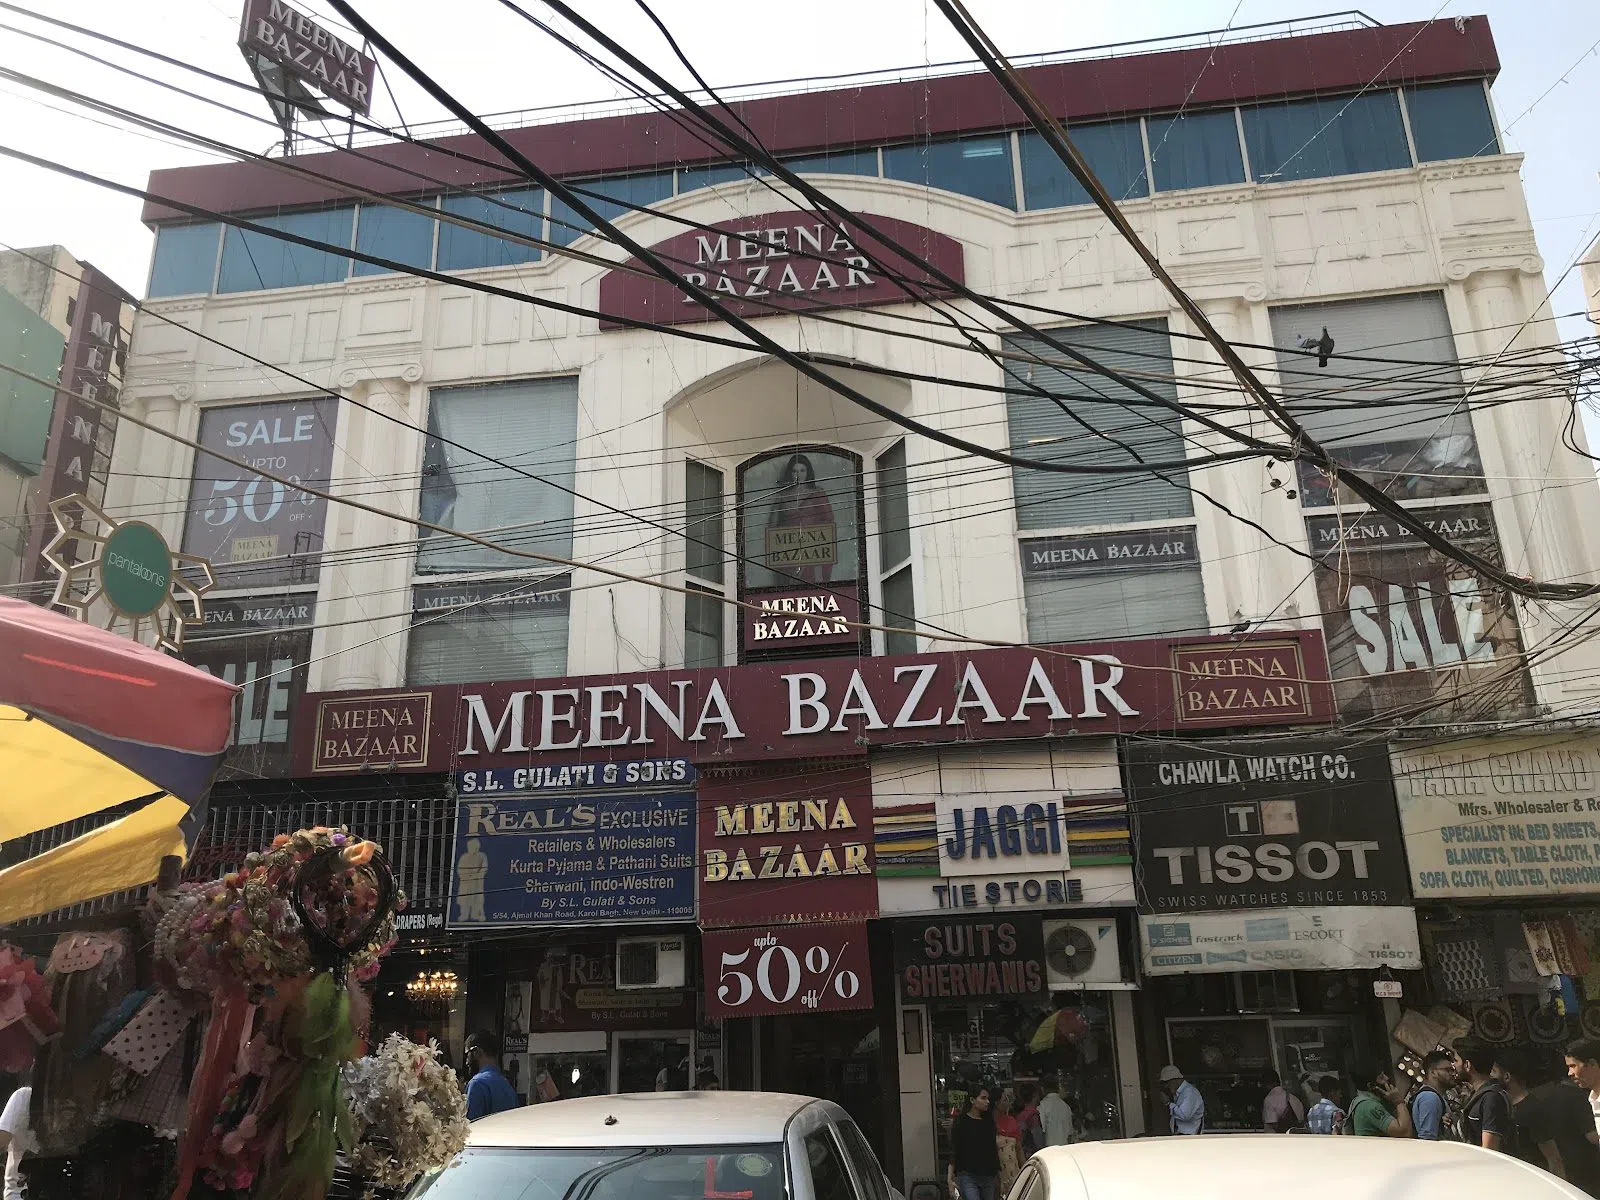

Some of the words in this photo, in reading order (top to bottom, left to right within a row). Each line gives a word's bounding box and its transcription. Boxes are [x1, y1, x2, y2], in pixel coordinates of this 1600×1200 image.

[269, 0, 364, 76] MEENA
[256, 17, 369, 106] BAZAAR
[695, 222, 856, 266] MEENA
[682, 256, 876, 303] BAZAAR
[226, 414, 315, 448] SALE
[775, 530, 827, 545] MEENA
[1398, 518, 1482, 536] BZAAR
[771, 546, 832, 563] BAZAAR
[1032, 547, 1099, 565] MEENA
[1107, 541, 1187, 560] BAZAAR
[107, 551, 165, 587] pantaloons
[241, 605, 309, 621] BAZAAR
[760, 595, 841, 618] MEENA
[753, 615, 850, 641] BAZAAR
[1350, 577, 1497, 676] SALE
[1187, 656, 1288, 681] MEENA
[457, 677, 746, 756] MEENA
[780, 653, 1140, 737] BAZAAR
[1187, 686, 1299, 712] BAZAAR
[331, 706, 414, 731] MEENA
[324, 733, 418, 760] BAZAAR
[463, 770, 504, 792] S.L.
[513, 765, 596, 789] GULATI
[602, 763, 618, 784] &
[626, 760, 687, 783] SONS
[1158, 759, 1241, 786] CHAWLA
[1246, 755, 1318, 782] WATCH
[1321, 754, 1356, 780] CO.
[599, 808, 689, 830] EXCLUSIVE
[714, 797, 857, 837] MEENA
[1228, 806, 1255, 832] T
[1457, 802, 1492, 816] Mfrs.
[1494, 799, 1569, 815] Wholesaler
[1573, 798, 1584, 812] &
[528, 838, 582, 853] Retailers
[586, 837, 596, 851] &
[600, 835, 676, 850] Wholesalers
[945, 802, 1062, 861] JAGGI
[1441, 824, 1505, 843] SPECIALIST
[1527, 823, 1550, 841] BED
[510, 858, 543, 874] Kurta
[547, 857, 593, 875] Pyjama
[596, 856, 605, 871] &
[609, 855, 657, 870] Pathani
[660, 853, 692, 869] Suits
[703, 842, 872, 882] BAZAAR
[1153, 840, 1380, 885] TISSOT
[1446, 847, 1511, 866] BLANKETS,
[1511, 845, 1549, 863] TABLE
[1550, 844, 1593, 864] CLOTH,
[525, 878, 586, 895] Sherwani,
[1419, 871, 1450, 889] SOFA
[1451, 869, 1494, 890] CLOTH,
[1495, 867, 1548, 888] QUILTED,
[541, 898, 554, 910] By
[556, 898, 579, 908] S.L.
[582, 896, 615, 907] Gulati
[617, 896, 625, 906] &
[628, 895, 657, 906] Sons
[932, 883, 978, 908] TIE
[985, 878, 1084, 905] STORE
[1158, 895, 1208, 909] SWISS
[1215, 892, 1288, 906] WATCHES
[1297, 890, 1345, 903] SINCE
[1352, 889, 1388, 902] 1853
[396, 914, 426, 930] DRAPERS
[492, 911, 509, 920] 5/54,
[511, 911, 532, 921] Ajmal
[533, 910, 553, 919] Khan
[555, 910, 577, 920] Road,
[578, 909, 598, 918] Karol
[623, 908, 639, 916] New
[753, 931, 778, 950] upto
[924, 923, 1017, 960] SUITS
[1195, 933, 1244, 943] fastrack
[1294, 929, 1345, 941] ESCORT
[1156, 956, 1194, 965] CITIZEN
[1368, 950, 1413, 959] TISSOT
[717, 941, 860, 1007] 50%
[906, 959, 1042, 999] SHERWANIS
[800, 989, 819, 1009] off
